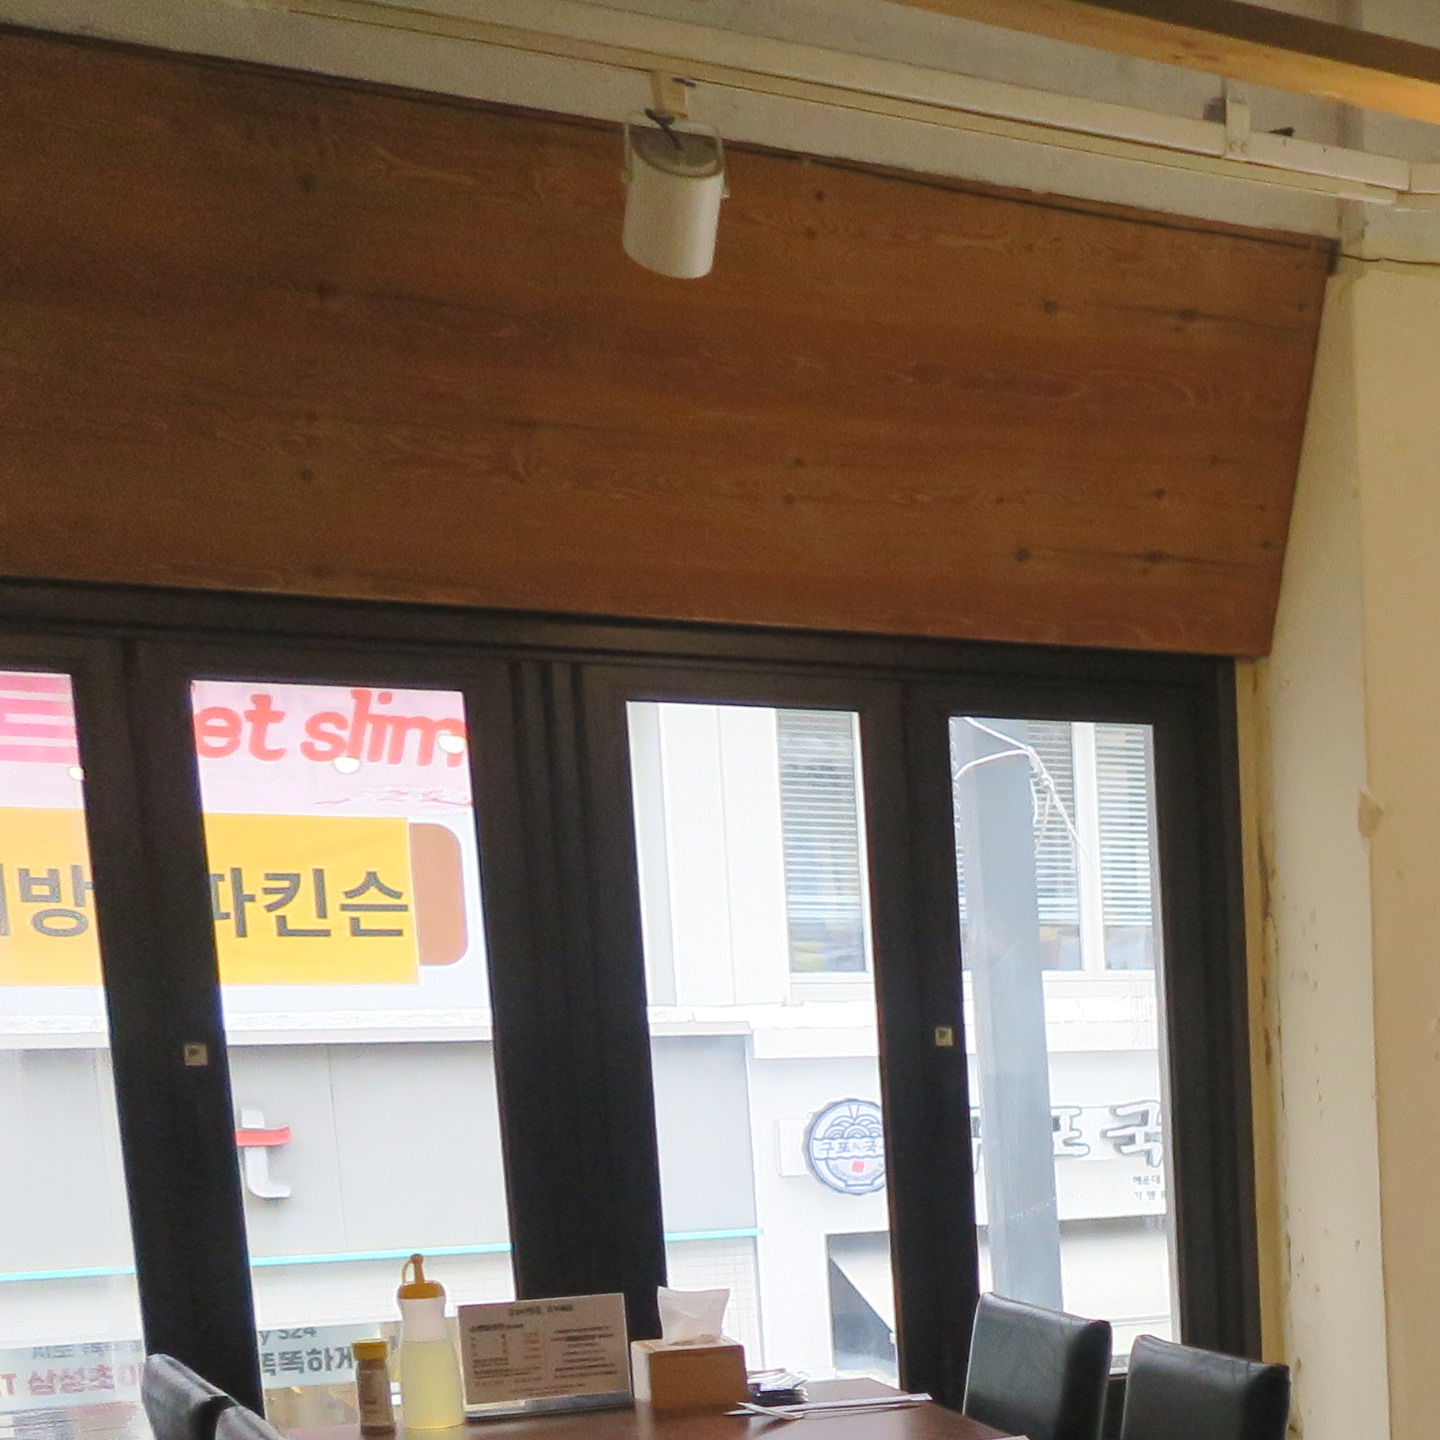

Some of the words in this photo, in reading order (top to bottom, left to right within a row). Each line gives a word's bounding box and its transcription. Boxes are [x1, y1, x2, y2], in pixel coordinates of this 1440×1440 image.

[193, 693, 287, 762] et
[0, 861, 97, 938] 방
[210, 866, 409, 938] 파킨슨
